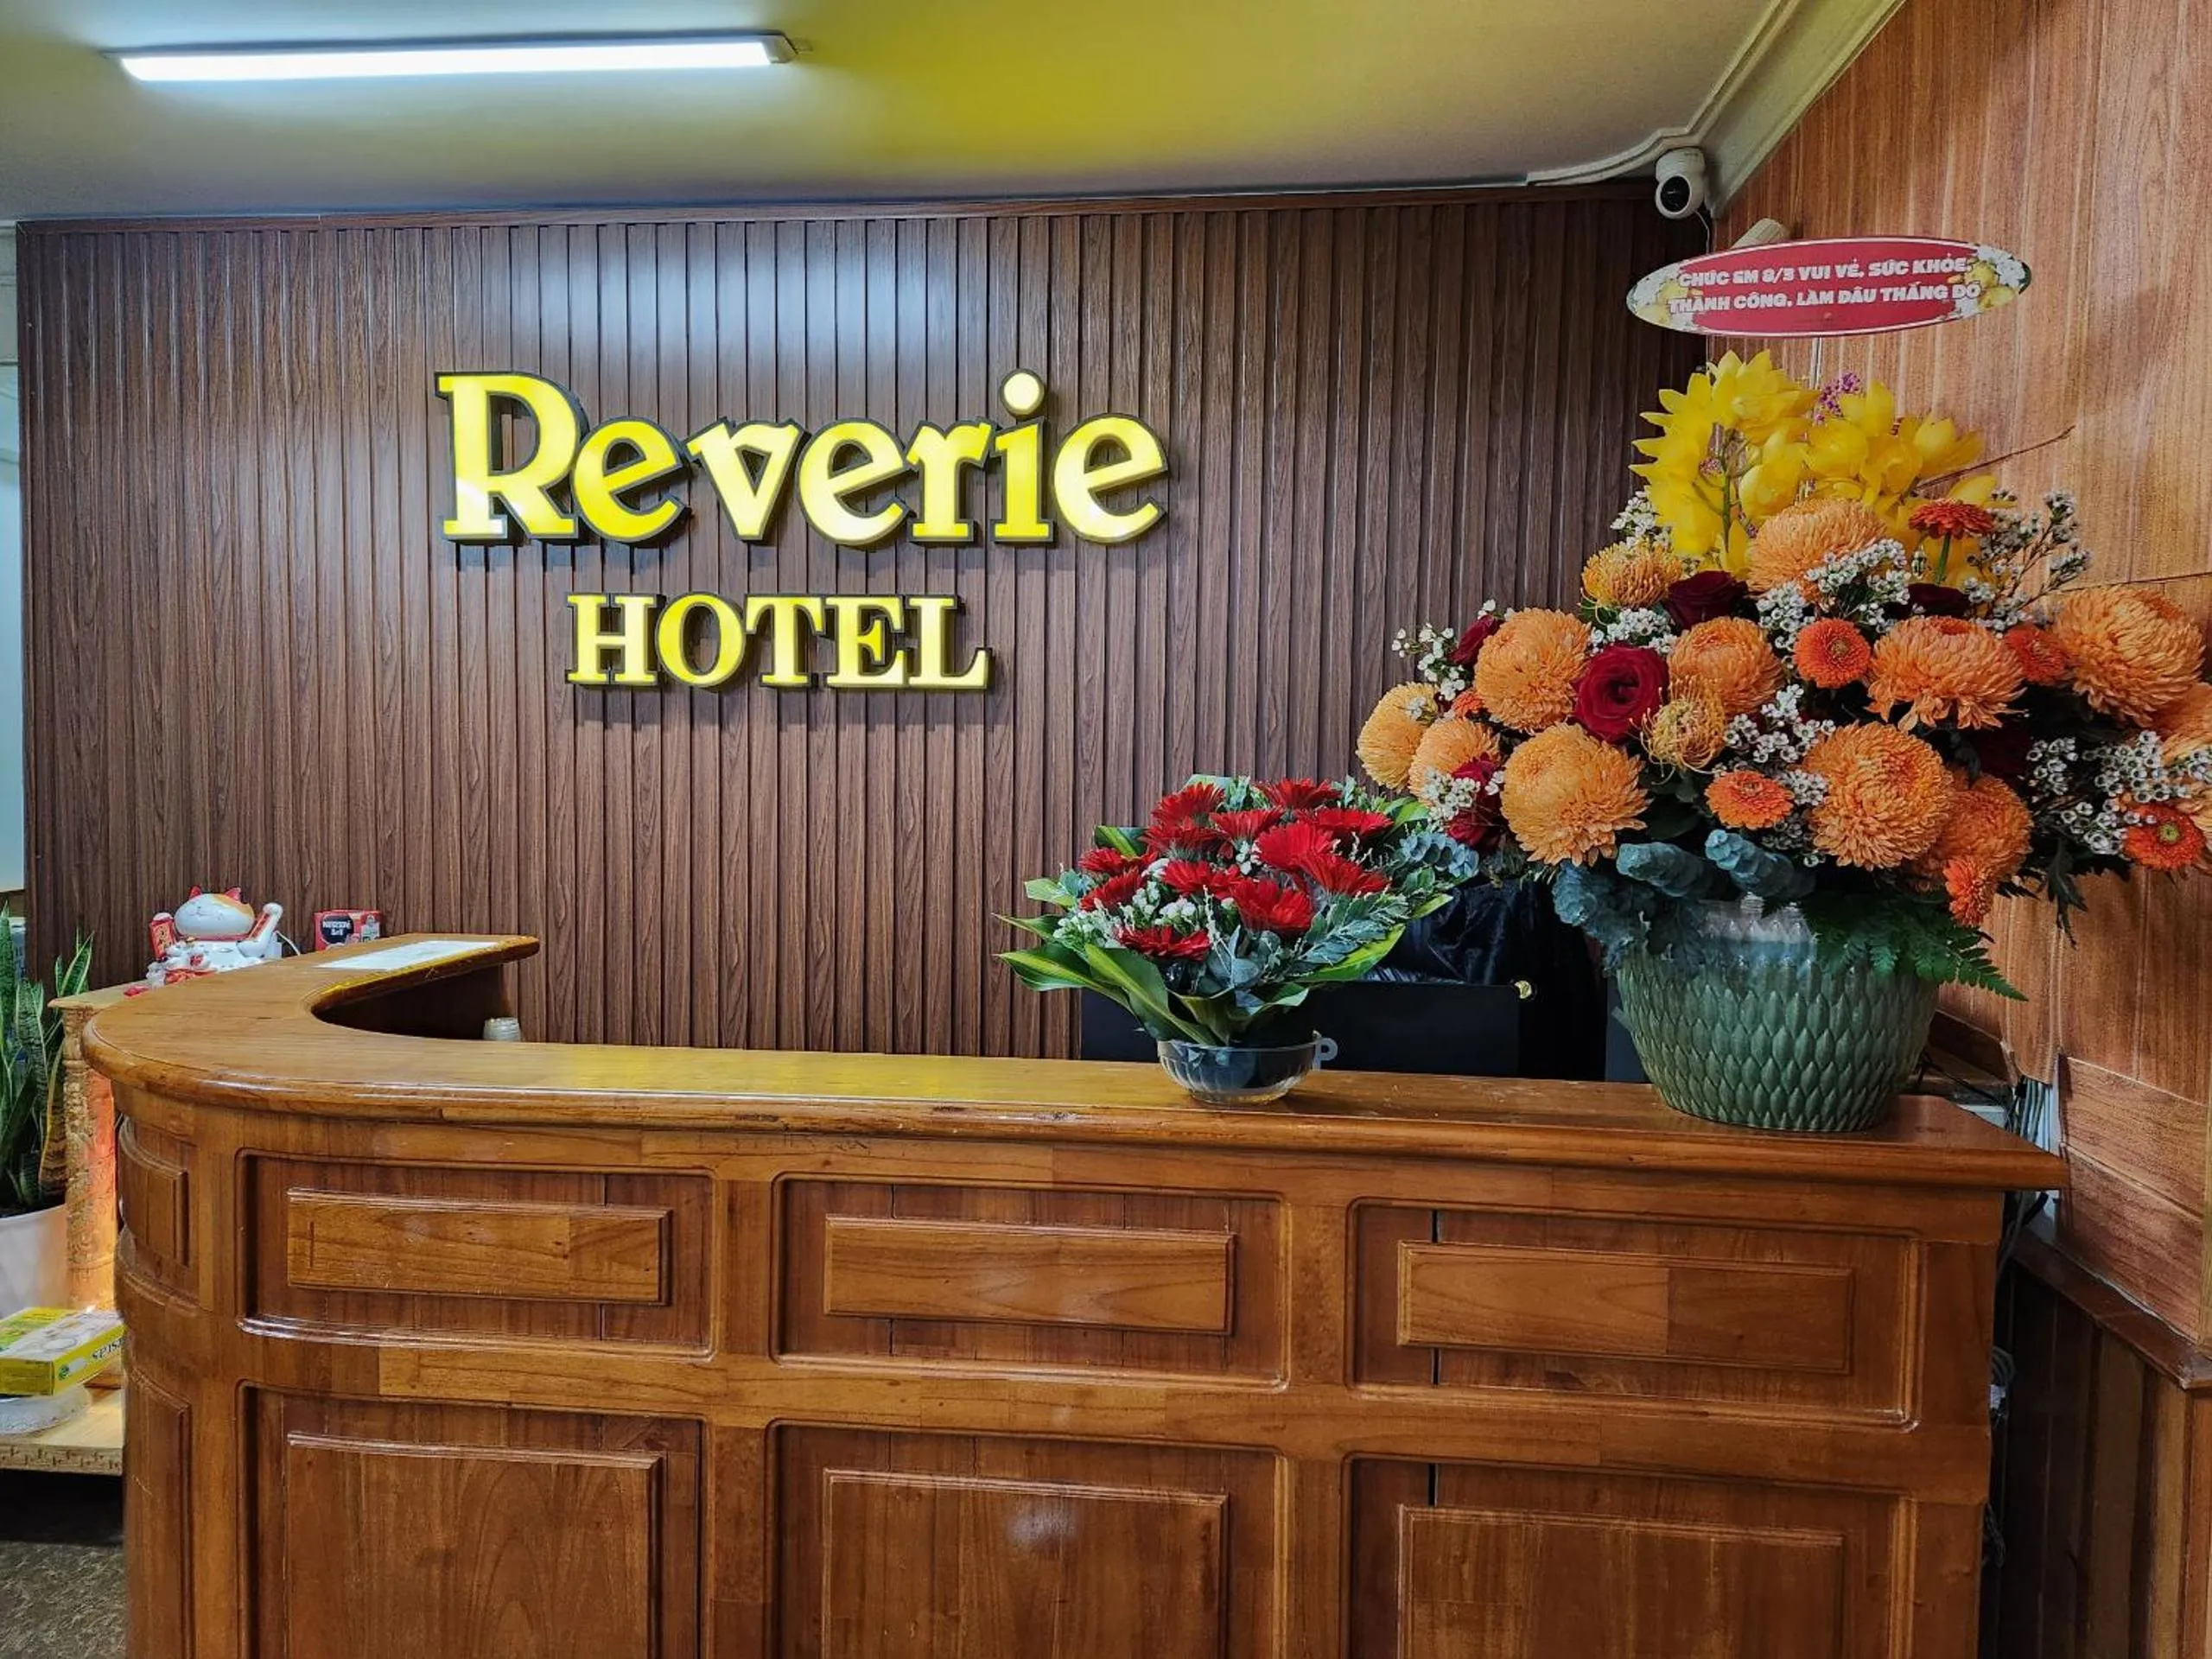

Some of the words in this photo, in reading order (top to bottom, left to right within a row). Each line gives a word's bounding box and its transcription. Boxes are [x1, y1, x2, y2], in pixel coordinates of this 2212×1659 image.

[1732, 269, 1758, 284] EM
[1762, 267, 1795, 285] 8/3
[1798, 264, 1831, 281] VUI
[435, 366, 1169, 546] Reverie
[565, 592, 995, 690] HOTEL
